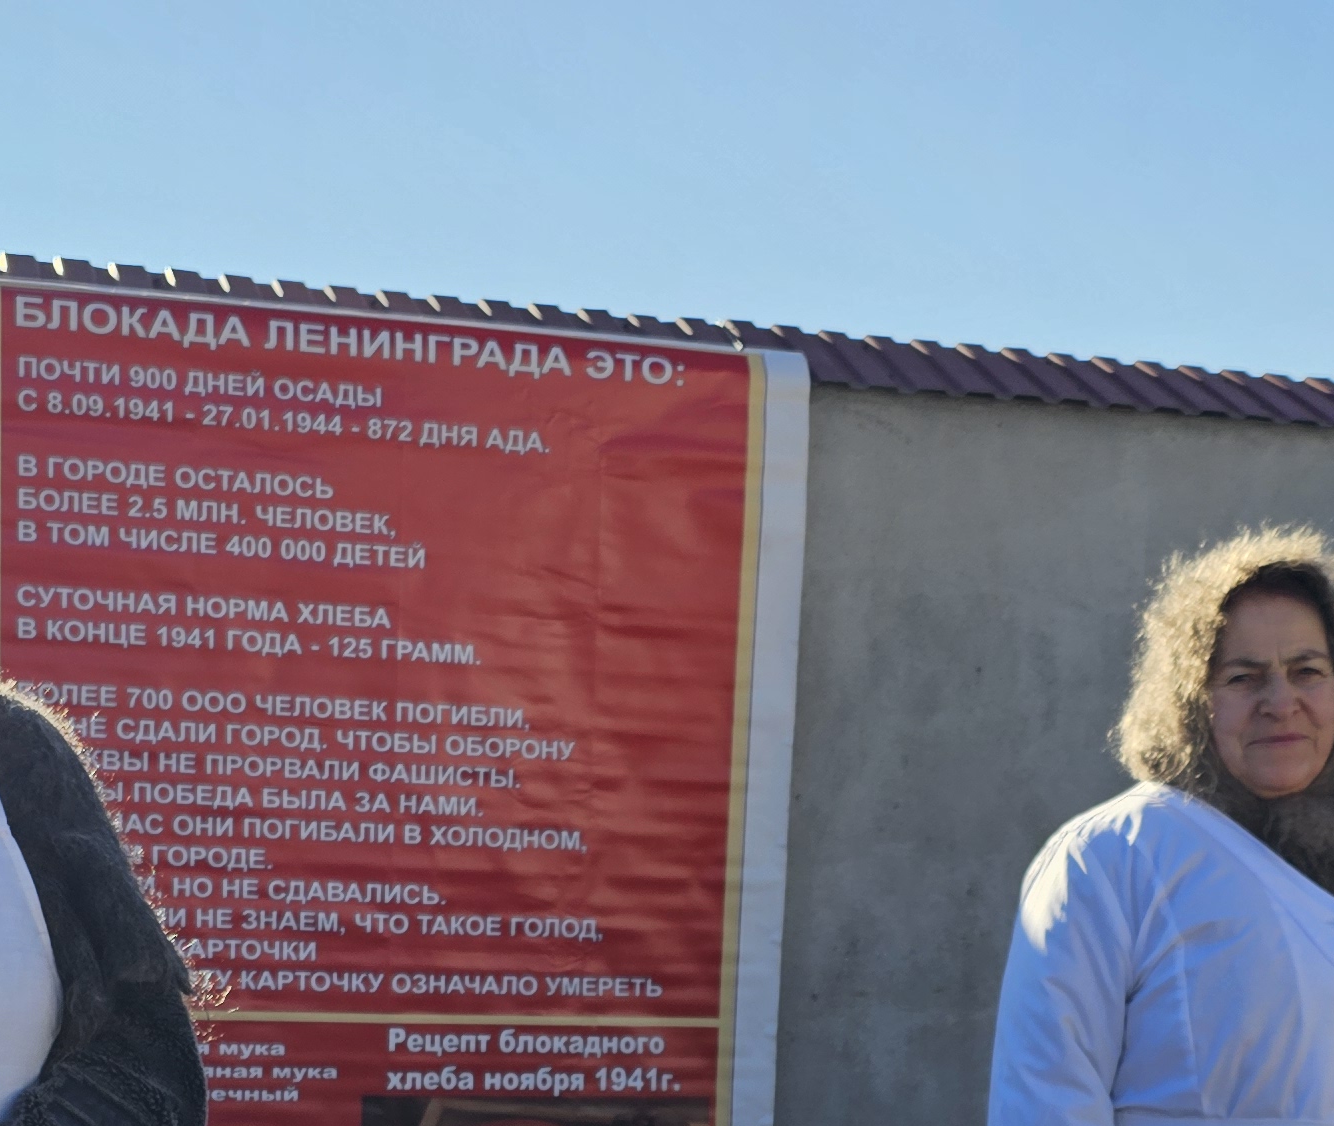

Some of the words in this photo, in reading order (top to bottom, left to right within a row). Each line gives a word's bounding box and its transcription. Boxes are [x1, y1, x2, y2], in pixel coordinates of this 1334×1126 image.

[16, 300, 250, 350] БЛОКАДА
[265, 320, 571, 379] ЛЕНИНГРАДА
[586, 352, 683, 386] ЭТО:
[19, 357, 119, 385] ПОЧТИ
[130, 366, 177, 390] 900
[185, 372, 264, 397] ДНЕЙ
[274, 379, 381, 408] ОСАДЫ
[18, 389, 37, 411] С
[48, 392, 173, 422] 8.09.1941
[203, 404, 343, 435] 27.01.1944
[368, 418, 412, 441] 872
[420, 422, 477, 448] ДНЯ
[486, 428, 549, 455] АДА.
[19, 455, 37, 476] В
[49, 458, 165, 488] ГОРОДЕ
[175, 468, 333, 498] ОСТАЛОСЬ
[19, 488, 118, 515] БОЛЕЕ
[128, 496, 167, 518] 2.5
[177, 500, 245, 524] МЛН.
[256, 506, 395, 538] ЧЕЛОВЕК,
[19, 521, 37, 541] В
[47, 523, 109, 546] ТОМ
[120, 528, 217, 554] ЧИСЛЕ
[226, 536, 271, 558] 400
[281, 539, 325, 561] 000
[333, 543, 425, 568] ДЕТЕЙ
[17, 586, 176, 614] СУТОЧНАЯ
[187, 596, 288, 622] НОРМА
[297, 604, 390, 628] ХЛЕБА
[17, 618, 36, 638] В
[47, 620, 146, 648] КОНЦЕ
[157, 626, 214, 648] 1941
[227, 630, 301, 657] ГОДА
[329, 637, 372, 658] 125
[381, 638, 481, 665] ГРАММ.
[127, 688, 172, 710] 700
[256, 695, 387, 720] ЧЕЛОВЕК
[397, 702, 529, 729] ПОГИБЛИ,
[117, 719, 215, 744] СДАЛИ
[337, 730, 436, 754] ЧТОБЫ
[445, 736, 575, 760] ОБОРОНУ
[159, 753, 195, 773] НЕ
[207, 754, 359, 780] ПРОРВАЛИ
[369, 762, 519, 788] ФАШИСТЫ.
[128, 782, 253, 810] ПОБЕДА
[263, 788, 346, 810] БЫЛА
[355, 792, 390, 812] ЗА
[400, 794, 483, 816] НАМИ.
[173, 816, 233, 836] ОНИ
[244, 818, 394, 843] ПОГИБАЛИ
[405, 824, 421, 844] В
[151, 846, 271, 872] ГОРОДЕ.
[173, 878, 212, 897] НО
[223, 879, 258, 898] НЕ
[269, 880, 445, 904] СДАВАЛИСЬ.
[197, 908, 232, 928] НЕ
[242, 910, 345, 934] ЗНАЕМ,
[355, 912, 409, 934] ЧТО
[417, 915, 501, 935] ТАКОЕ
[511, 916, 601, 940] ГОЛОД,
[237, 971, 383, 992] КАРТОЧКУ
[392, 974, 537, 995] ОЗНАЧАЛО
[546, 977, 662, 996] УМЕРЕТЬ
[220, 1044, 285, 1059] мука
[389, 1028, 490, 1056] Рецепт
[500, 1029, 664, 1058] блокадного
[273, 1068, 337, 1081] мука
[387, 1066, 473, 1090] хлеба
[485, 1067, 584, 1096] ноября
[596, 1068, 680, 1090] 1941г.
